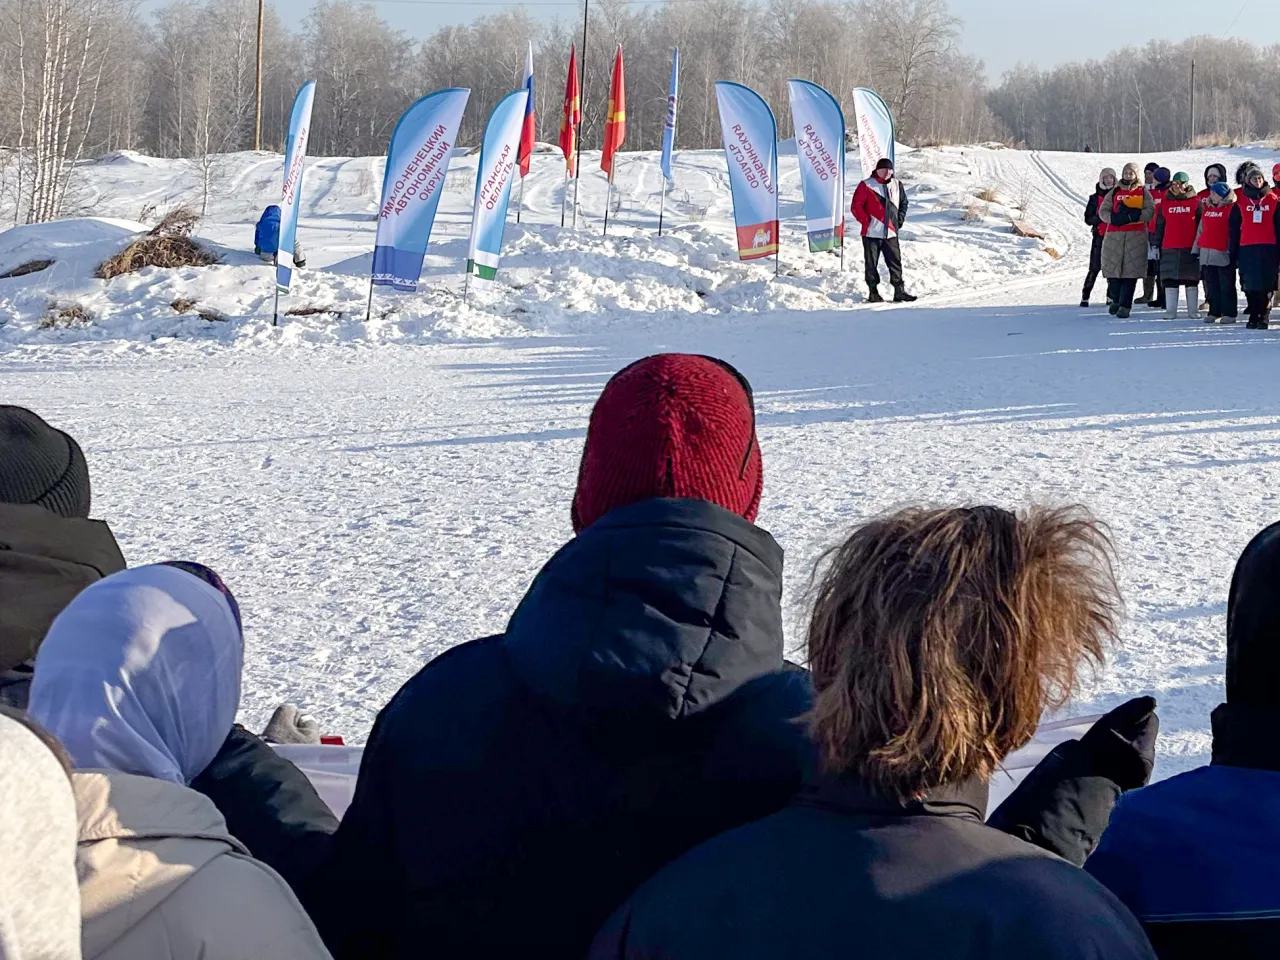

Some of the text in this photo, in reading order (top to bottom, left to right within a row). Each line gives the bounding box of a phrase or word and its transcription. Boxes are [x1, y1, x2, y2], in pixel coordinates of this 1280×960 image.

[381, 124, 447, 220] ЯМАЛО-НЕНЕЦКИЙ
[394, 141, 451, 216] АВТОНОМНЫЙ
[419, 167, 446, 201] ОКРУГ
[485, 162, 514, 210] ОБЛАСТЬ
